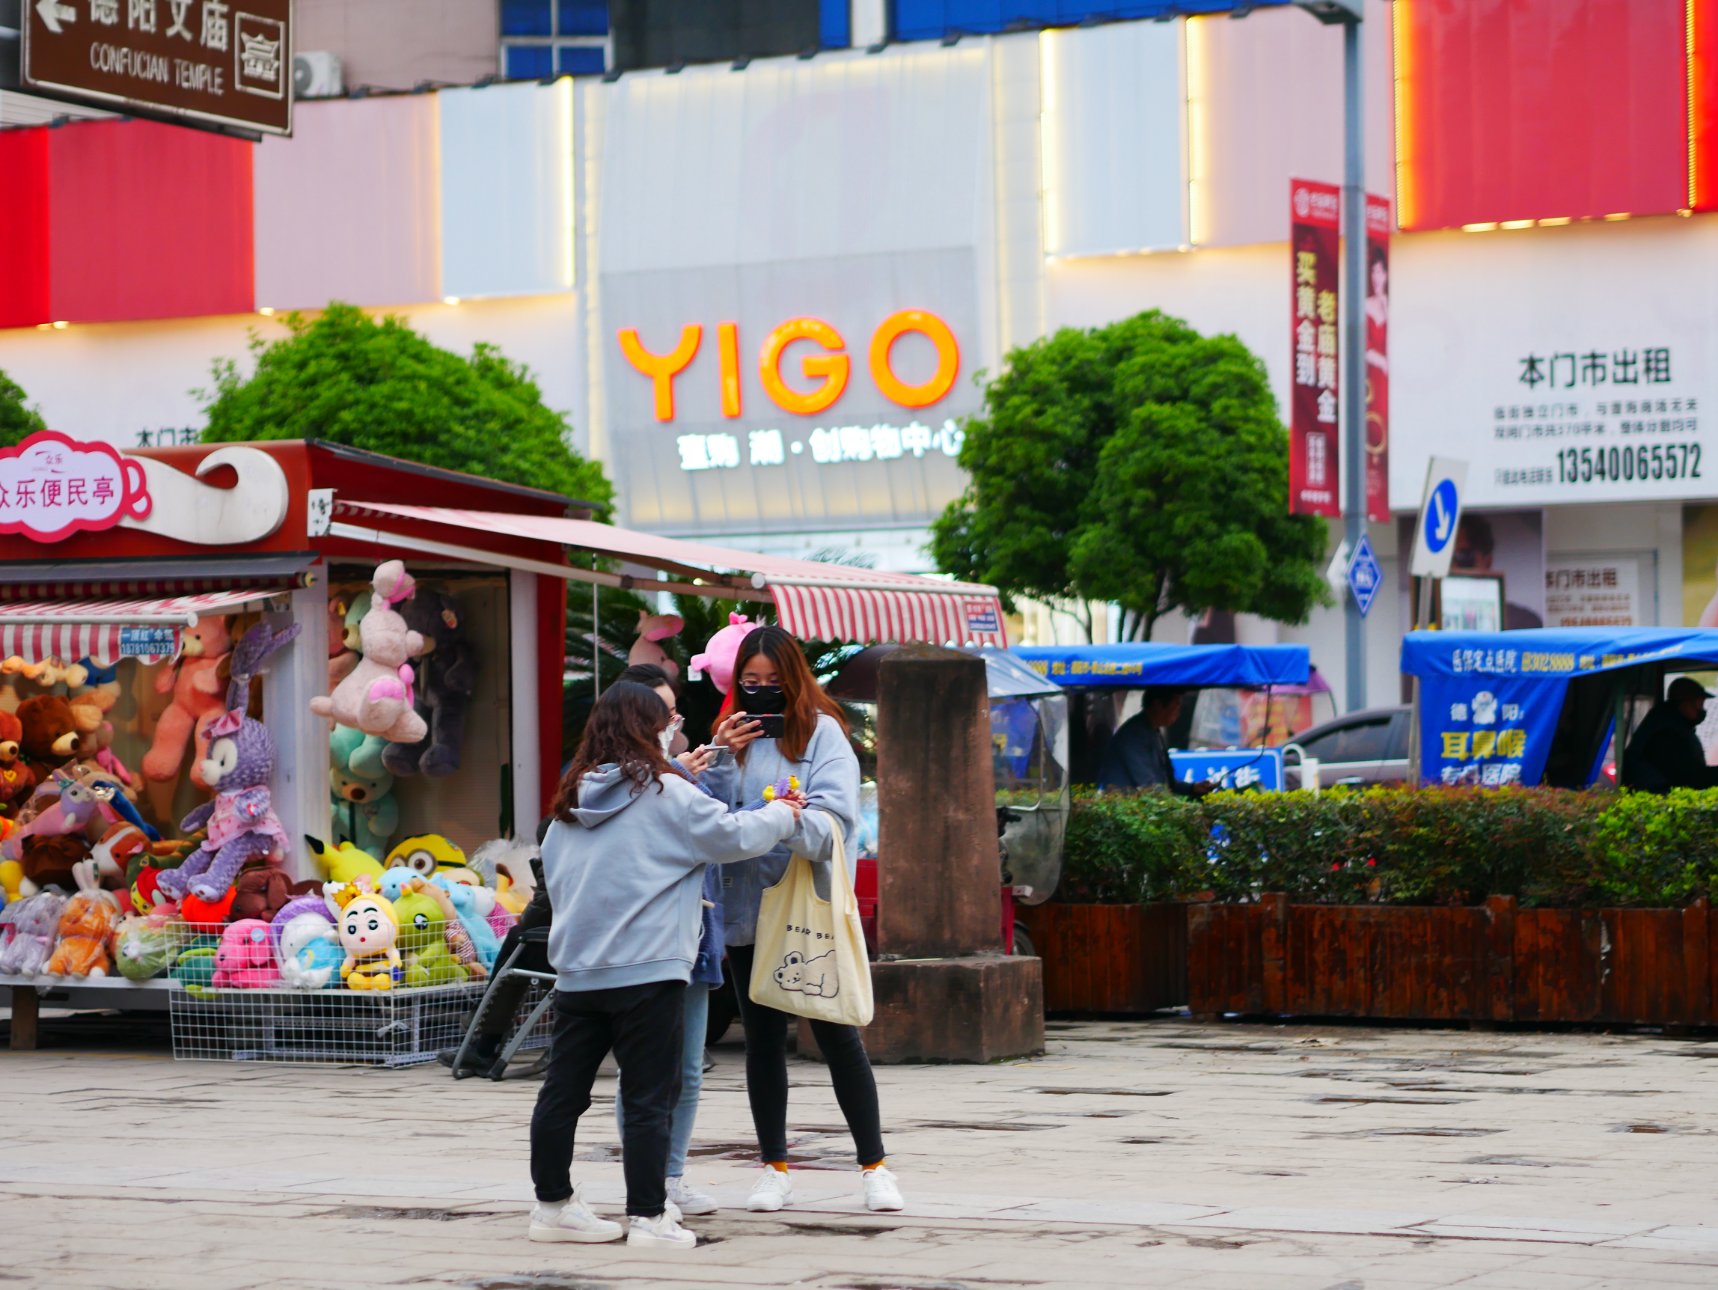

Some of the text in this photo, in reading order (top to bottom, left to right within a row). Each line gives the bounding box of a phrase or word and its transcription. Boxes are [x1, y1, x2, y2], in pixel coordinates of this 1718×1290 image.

[90, 41, 224, 95] CONFUCIAN TEMPLE
[617, 308, 960, 423] YIGO
[1518, 348, 1671, 388] 本门市出租
[1557, 443, 1702, 483] 13540065572
[787, 925, 811, 936] BEAR
